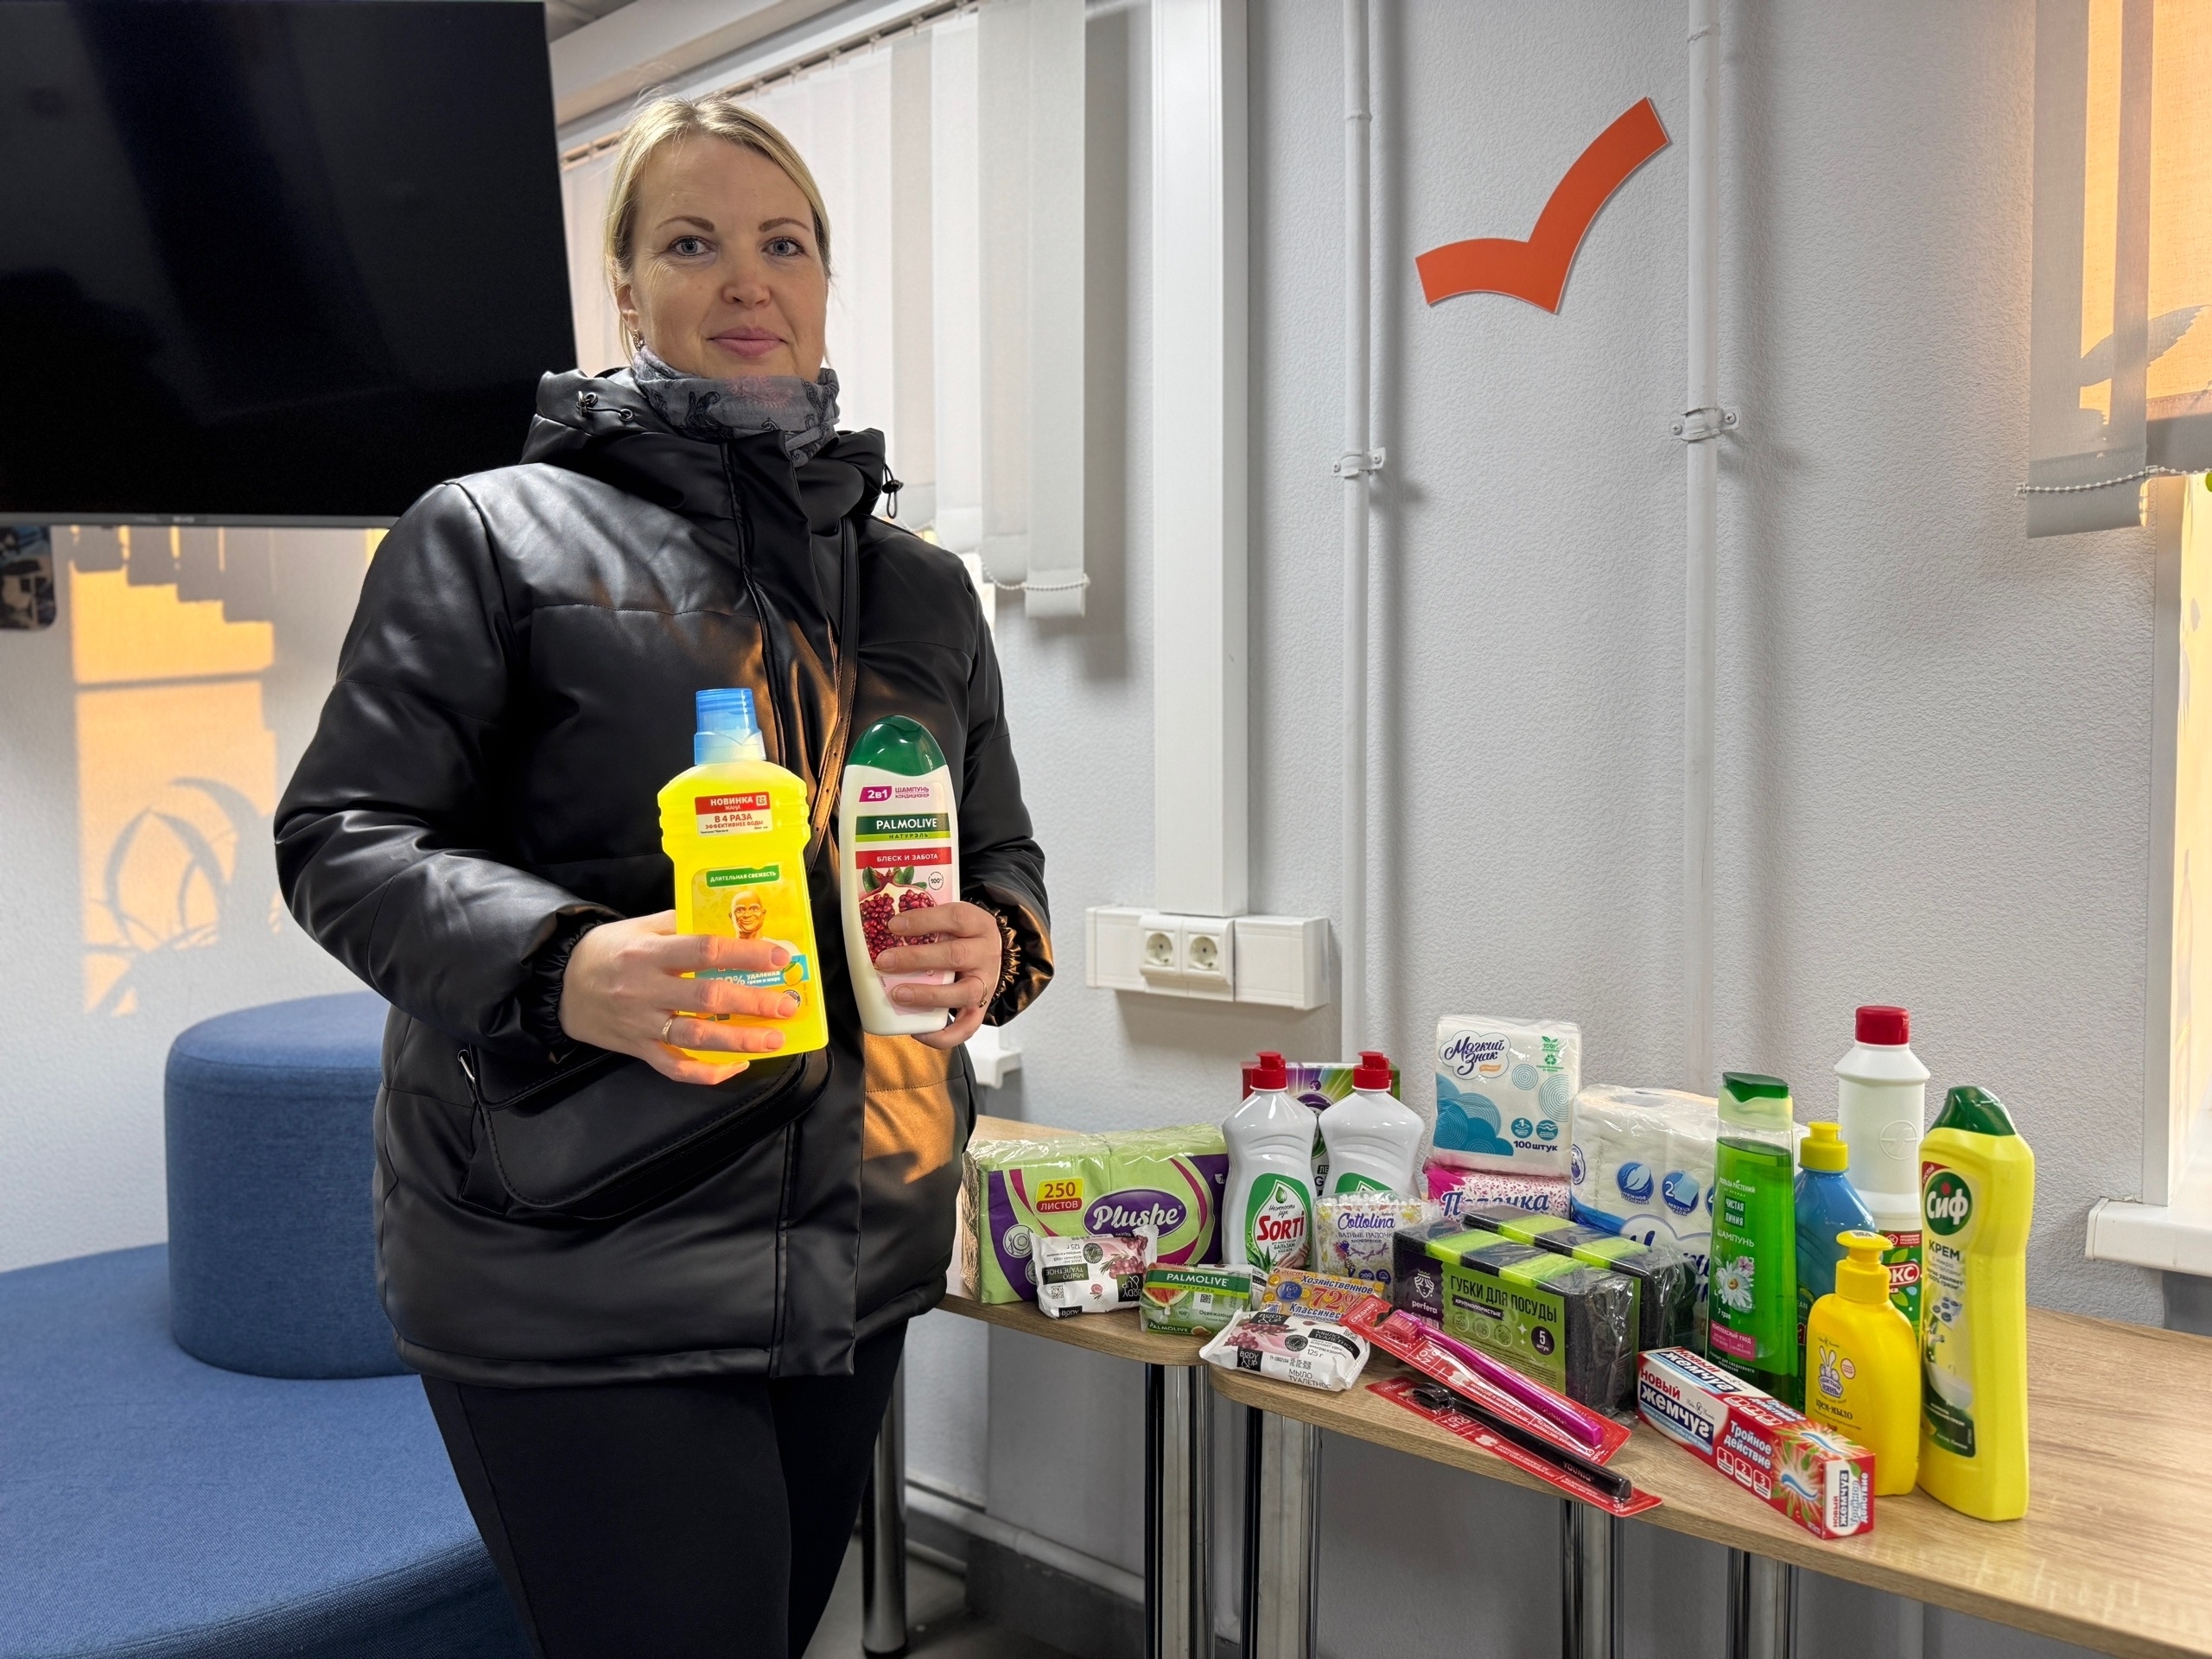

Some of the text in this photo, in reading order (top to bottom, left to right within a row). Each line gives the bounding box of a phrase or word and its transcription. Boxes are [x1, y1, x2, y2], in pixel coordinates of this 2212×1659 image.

[710, 796, 753, 806] НОВИНКА
[868, 790, 887, 799] 2в1
[730, 813, 753, 822] РАЗА
[876, 818, 938, 830] PALMOLIVE
[710, 874, 747, 883] ДЛИТЕЛЬНАЯ
[1444, 1036, 1504, 1062] Мягкий
[1458, 1052, 1498, 1076] Знак
[1513, 1141, 1558, 1153] 100 штук
[1044, 1181, 1077, 1198] 250
[1665, 1181, 1675, 1198] 2
[1040, 1200, 1078, 1211] ЛИСТОВ
[1726, 1198, 1745, 1211] ЧИСТАЯ
[1927, 1188, 1969, 1225] Сиф
[1092, 1203, 1180, 1230] Plushe
[1338, 1212, 1395, 1230] Cottolina
[1725, 1212, 1744, 1227] ЛИНИЯ
[1717, 1228, 1755, 1248] ШАМПУНЬ
[1929, 1239, 1961, 1262] КРЕМ
[1046, 1267, 1084, 1276] ТУАЛЕТНОЕ
[1166, 1273, 1228, 1287] PALMOLIVE
[1301, 1274, 1374, 1294] Хозяйственное
[1178, 1284, 1215, 1293] НАТУРЭЛЬ
[1451, 1274, 1557, 1324] ГУБКИ ДЛЯ ПОСУДЫ
[1350, 1302, 1376, 1324] СРЕДНЯЯ
[1411, 1300, 1438, 1314] perfera
[1454, 1298, 1502, 1318] КРУПНОПОРИСТЫЕ
[1149, 1323, 1188, 1332] PALMOLIVE
[1539, 1331, 1546, 1344] 5
[1239, 1351, 1259, 1359] BODY
[1675, 1347, 1722, 1374] НОВЫЙ
[1241, 1357, 1258, 1369] &UP
[1288, 1368, 1313, 1379] МЫЛО
[1641, 1370, 1681, 1402] НОВЫЙ
[1730, 1420, 1772, 1455] Тройное
[1722, 1453, 1727, 1463] 1
[1723, 1434, 1771, 1470] действие
[1562, 1461, 1592, 1482] YOUNIQ
[1741, 1463, 1746, 1472] 2
[1759, 1473, 1766, 1484] 3
